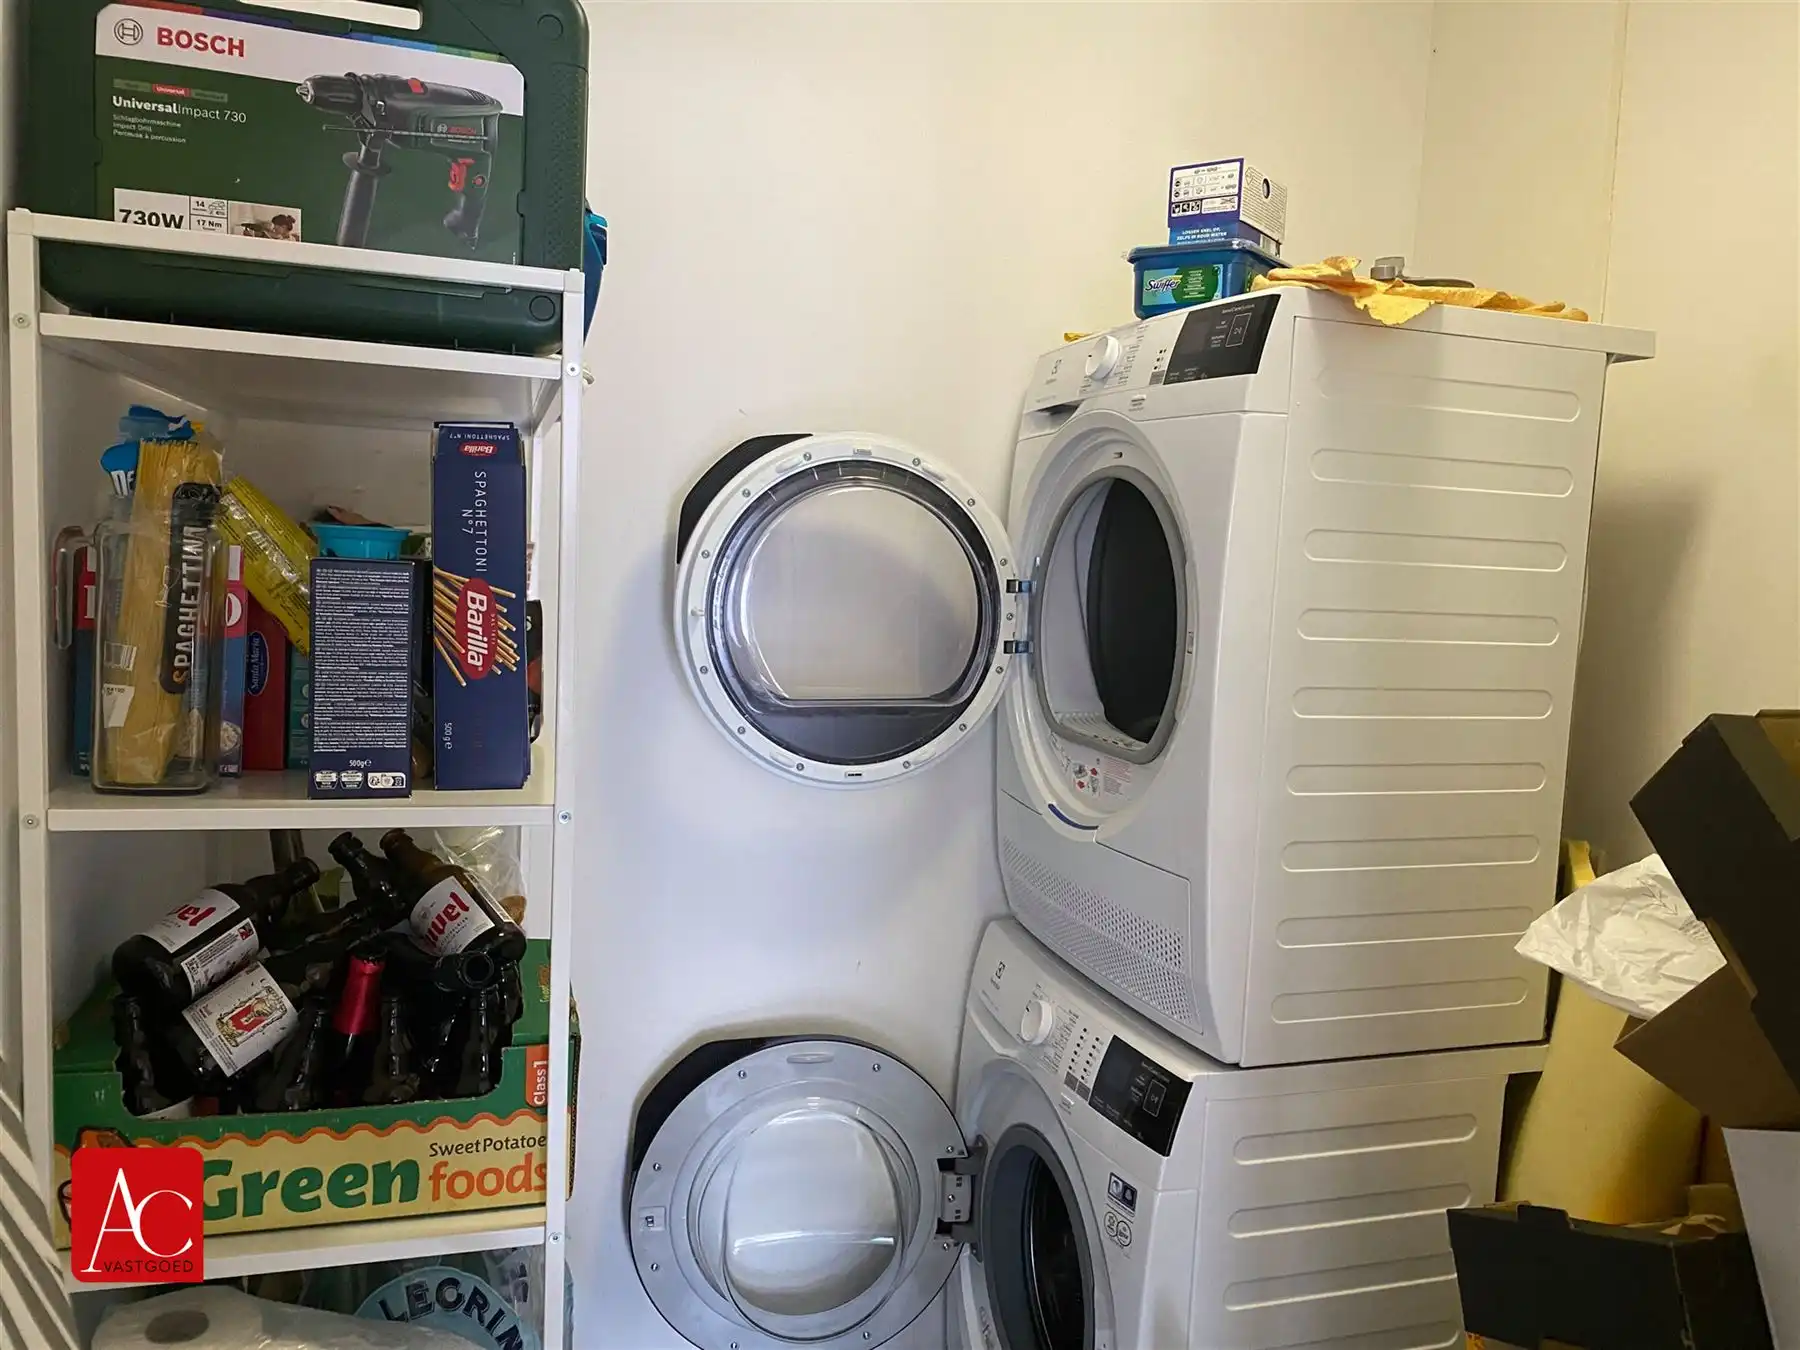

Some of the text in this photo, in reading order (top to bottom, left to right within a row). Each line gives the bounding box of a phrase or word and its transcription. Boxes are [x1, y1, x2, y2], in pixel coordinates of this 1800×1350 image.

[157, 27, 244, 57] BOSCH
[112, 95, 220, 118] UniversalImpact
[223, 110, 247, 123] 730
[112, 114, 182, 128] Schlagbohrmaschine
[112, 122, 136, 131] Impact
[150, 133, 186, 144] percussion
[118, 208, 184, 229] 730W
[1145, 279, 1181, 291] Swiffer
[464, 445, 494, 454] Barilla
[474, 471, 488, 572] SPAGHETTONI
[467, 590, 488, 667] Barilla
[250, 637, 260, 690] Santa Maria
[534, 1068, 546, 1105] Class
[204, 1158, 420, 1221] Green
[429, 1152, 546, 1202] foods
